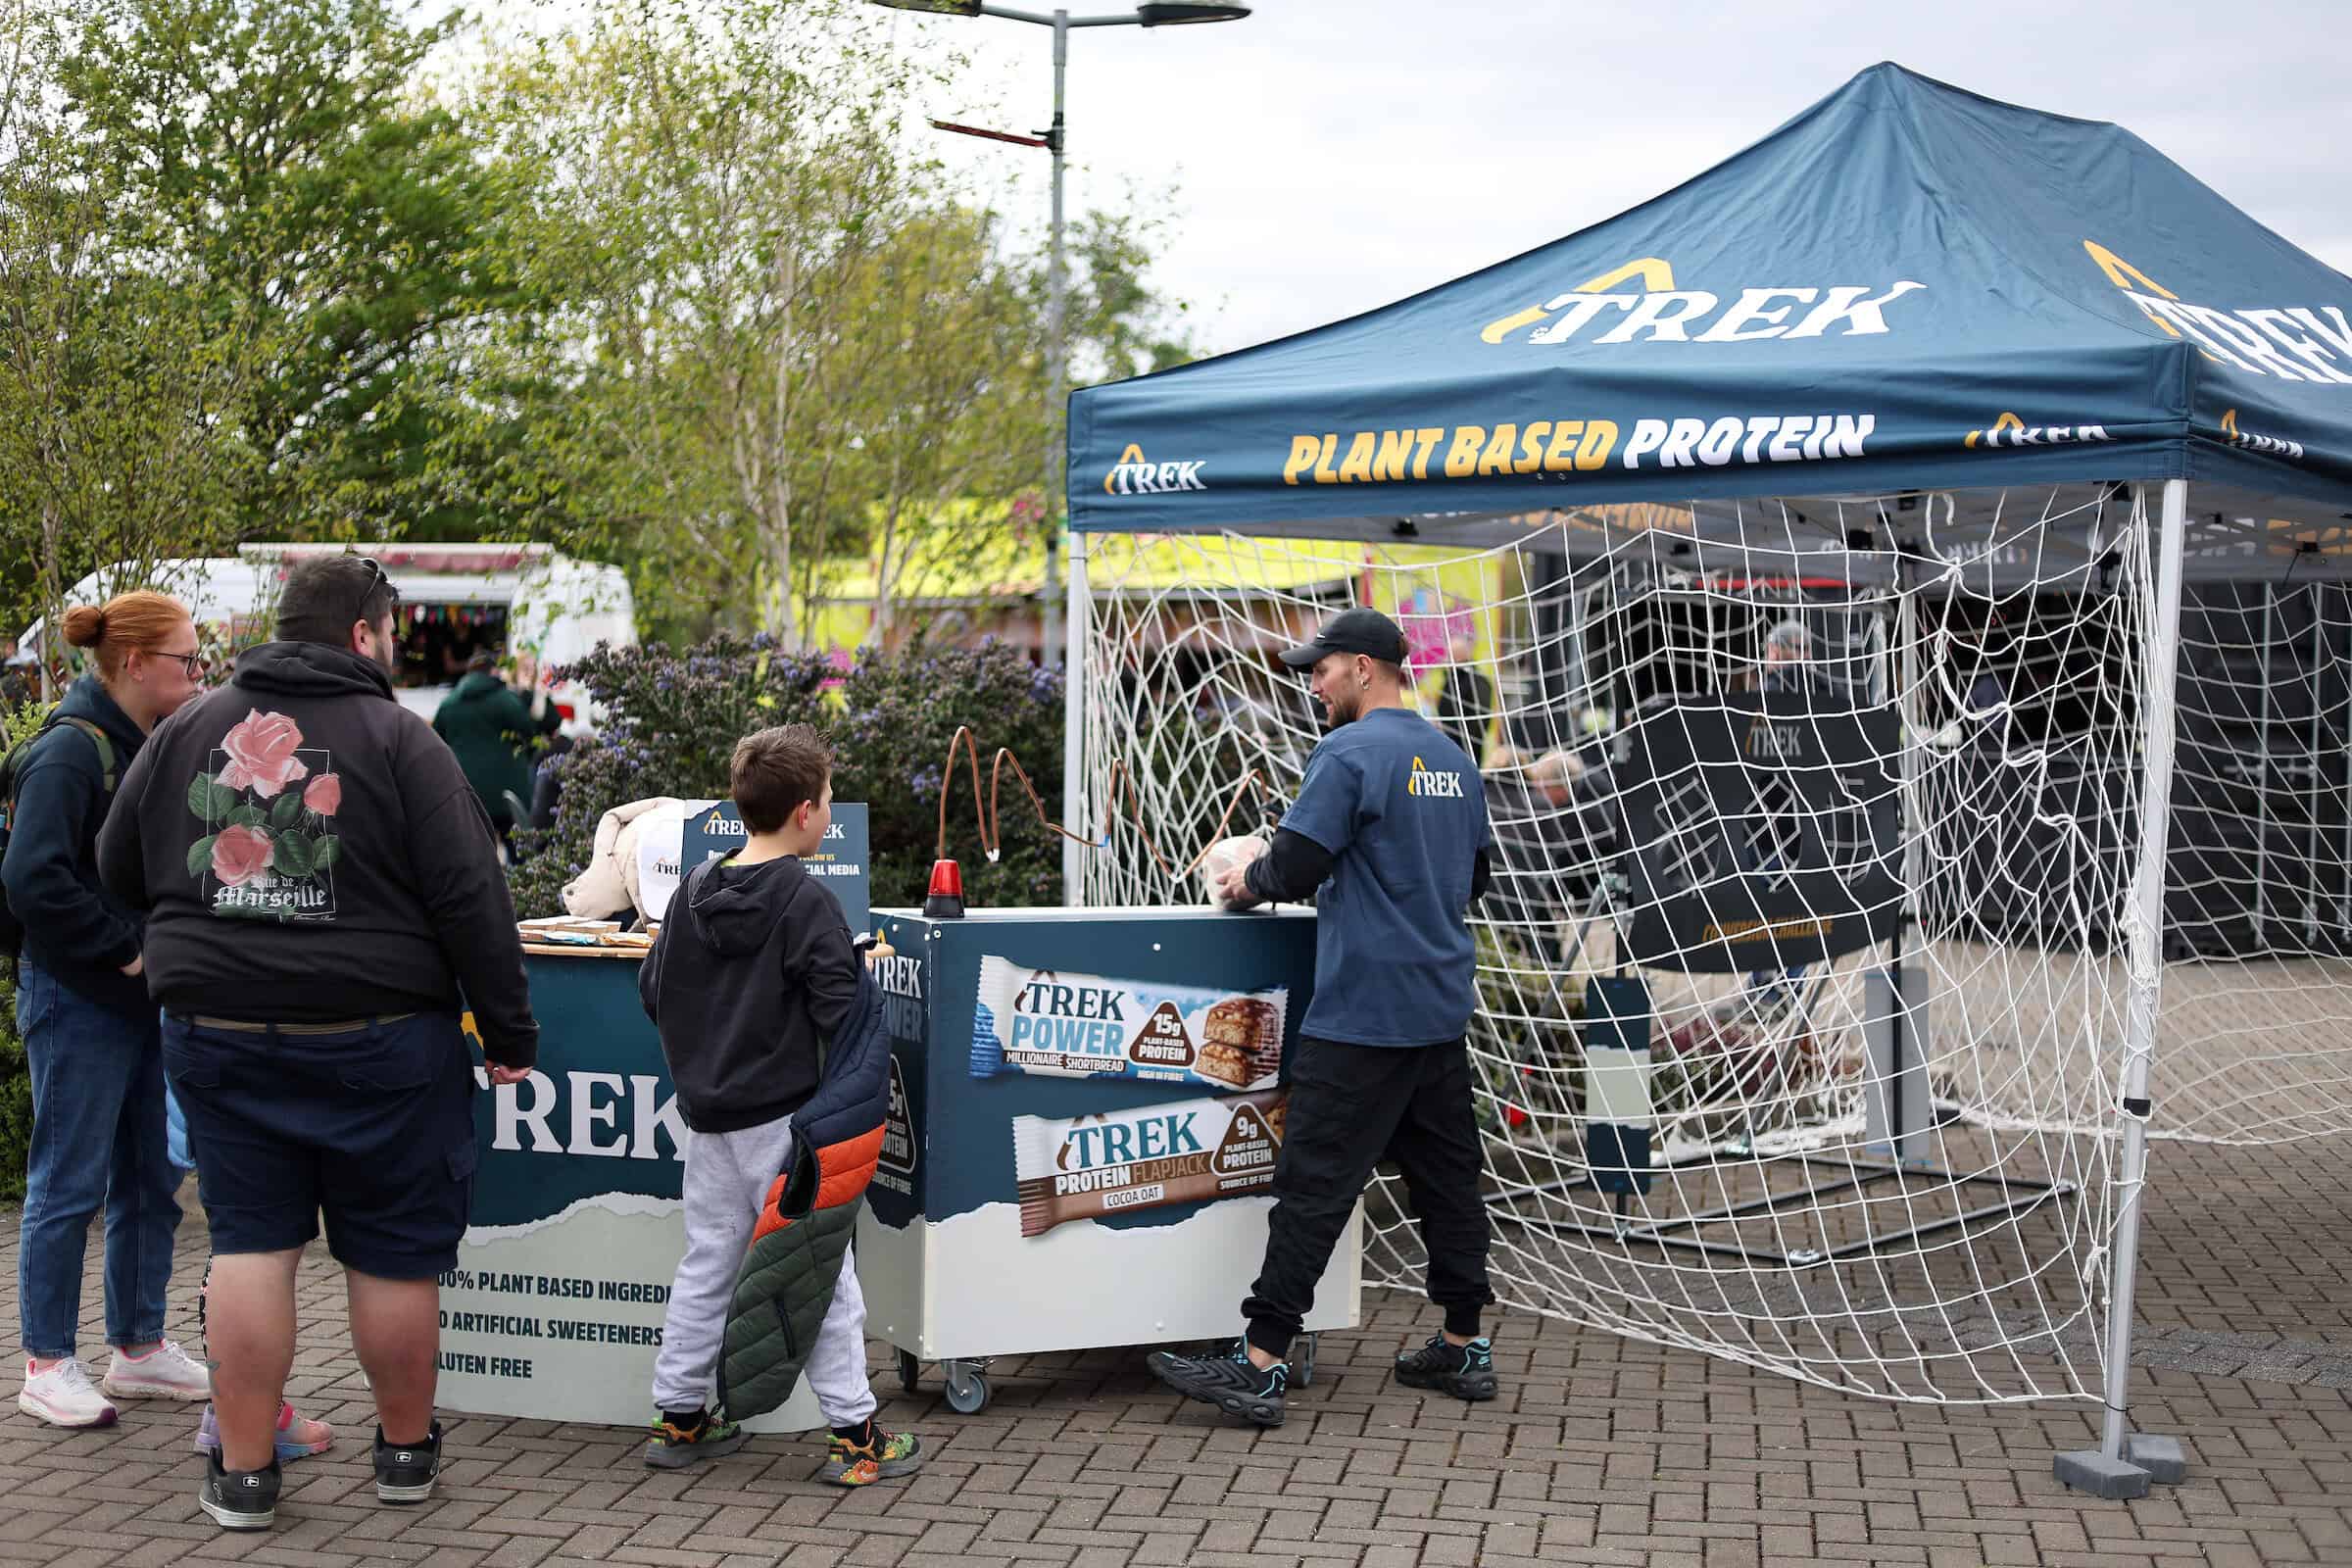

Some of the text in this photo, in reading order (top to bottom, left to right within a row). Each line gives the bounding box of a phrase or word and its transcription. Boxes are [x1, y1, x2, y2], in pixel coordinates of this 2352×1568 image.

[1529, 280, 1929, 344] TREK
[1283, 414, 1876, 485] PLANT BASED PROTEIN
[1111, 460, 1207, 495] TREK
[1750, 726, 1801, 756] TREK
[1411, 770, 1464, 798] TREK
[823, 823, 845, 839] EK
[827, 863, 860, 875] MEDIA
[213, 885, 326, 907] Marseille
[1026, 982, 1125, 1021] TREK
[885, 995, 922, 1044] WER
[1010, 1015, 1124, 1056] POWER
[1153, 1013, 1182, 1037] 15g
[1005, 1051, 1125, 1072] MILLIONAIRE SHORTBREAD
[1138, 1044, 1187, 1061] PROTEIN
[473, 1066, 687, 1161] REK
[888, 1078, 904, 1117] 5g
[1067, 1112, 1203, 1168] TREK
[1236, 1115, 1258, 1139] 9g
[1222, 1148, 1273, 1169] PROTEIN
[1055, 1154, 1207, 1197] PROTEIN FLAPJACK
[1106, 1186, 1159, 1207] COCOA OAT
[437, 1270, 671, 1304] 00% PLANT BASED INGREDI
[438, 1309, 664, 1347] O ARTIFICIAL SWEETENERS
[437, 1350, 533, 1379] LUTEN FREE
